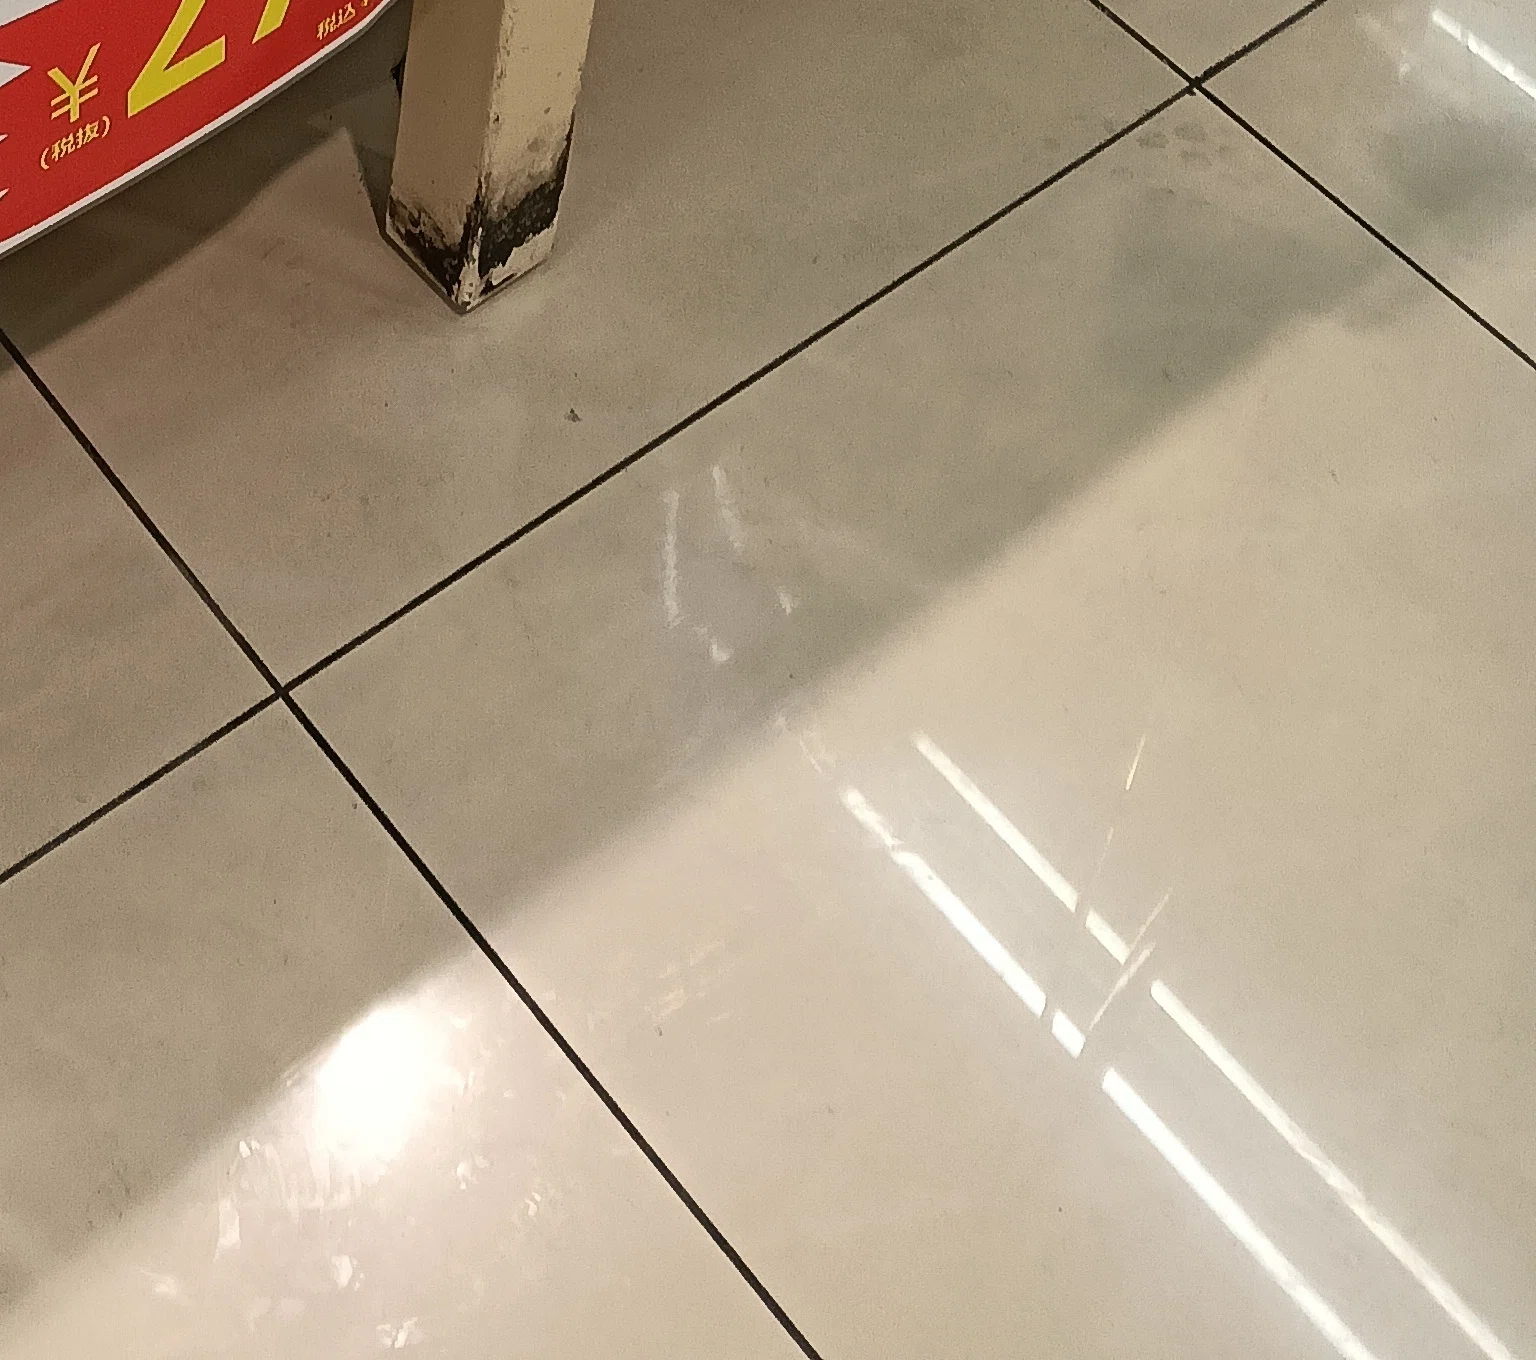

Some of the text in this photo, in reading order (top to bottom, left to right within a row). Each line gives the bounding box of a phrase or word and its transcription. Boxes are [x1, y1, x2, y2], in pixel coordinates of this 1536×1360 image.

[315, 2, 357, 41] 税込
[47, 41, 102, 124] ¥
[38, 114, 112, 171] (税抜)
